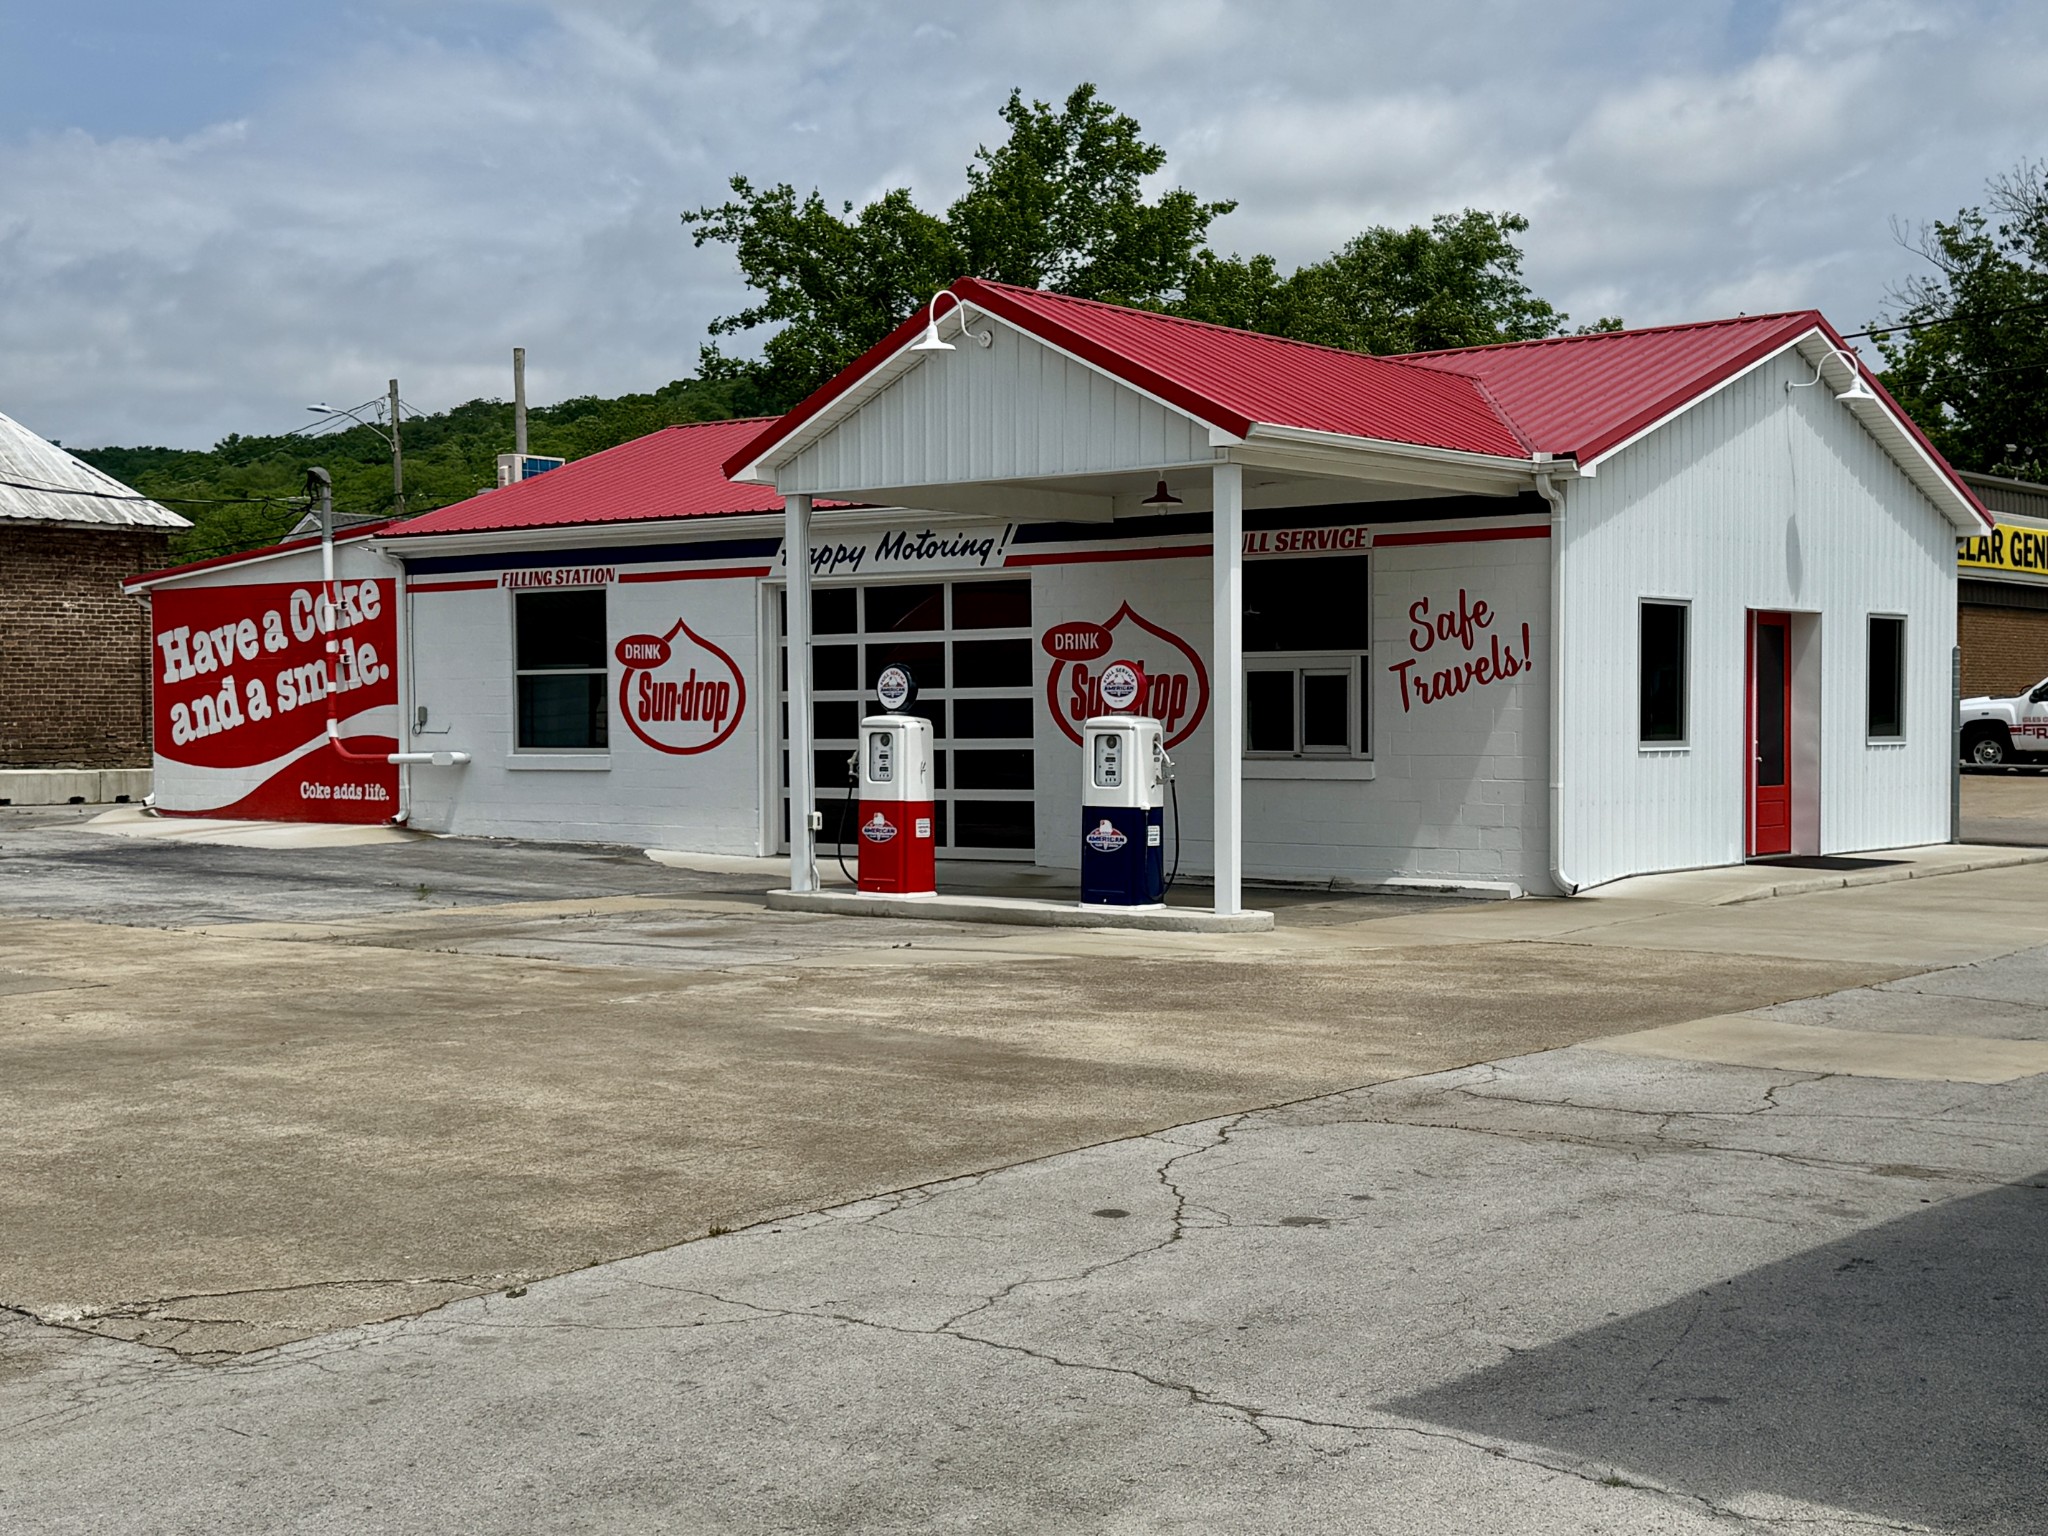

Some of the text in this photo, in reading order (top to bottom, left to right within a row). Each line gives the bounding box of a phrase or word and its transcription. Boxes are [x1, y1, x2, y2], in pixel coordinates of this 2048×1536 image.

[782, 523, 1012, 574] appy Motoring!
[1275, 527, 1368, 552] SERVICE
[2010, 531, 2048, 569] GEN
[501, 567, 616, 587] FILLING STATION
[157, 579, 380, 684] Have a Coke
[1055, 632, 1099, 650] DRINK
[1409, 589, 1494, 652] Safe
[625, 643, 661, 660] DRINK
[1388, 623, 1532, 713] Travels!
[170, 637, 389, 746] and a smile.
[638, 668, 730, 733] Sun-drop
[300, 781, 390, 801] Coke adds life.
